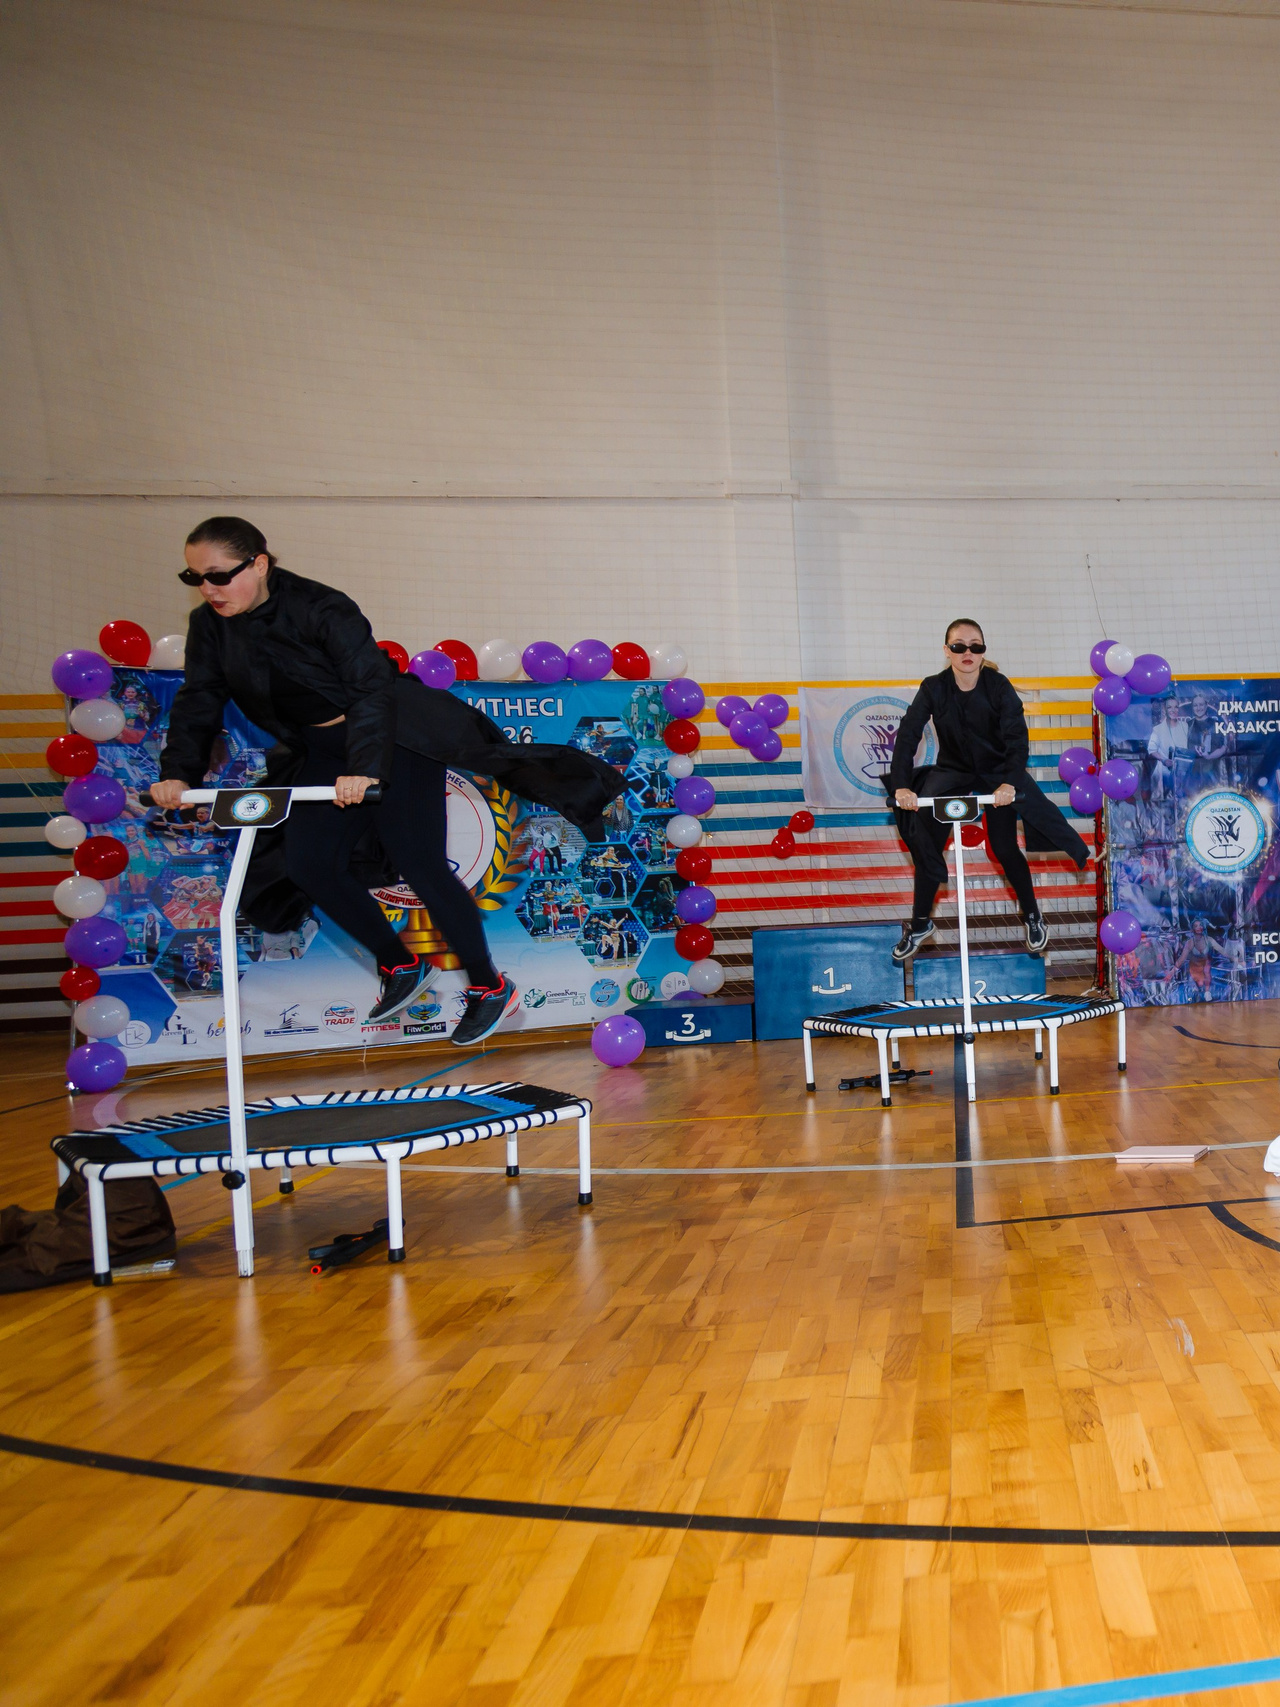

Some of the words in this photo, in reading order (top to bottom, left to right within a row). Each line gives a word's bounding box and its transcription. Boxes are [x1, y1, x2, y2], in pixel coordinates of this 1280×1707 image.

[467, 697, 564, 718] ИТНЕСІ
[502, 725, 535, 744] 26
[1255, 950, 1279, 964] ПО
[823, 967, 834, 987] 1
[974, 980, 987, 998] 2
[324, 1017, 356, 1026] TRADE
[361, 1023, 400, 1033] FITNESS
[681, 1013, 696, 1034] 3
